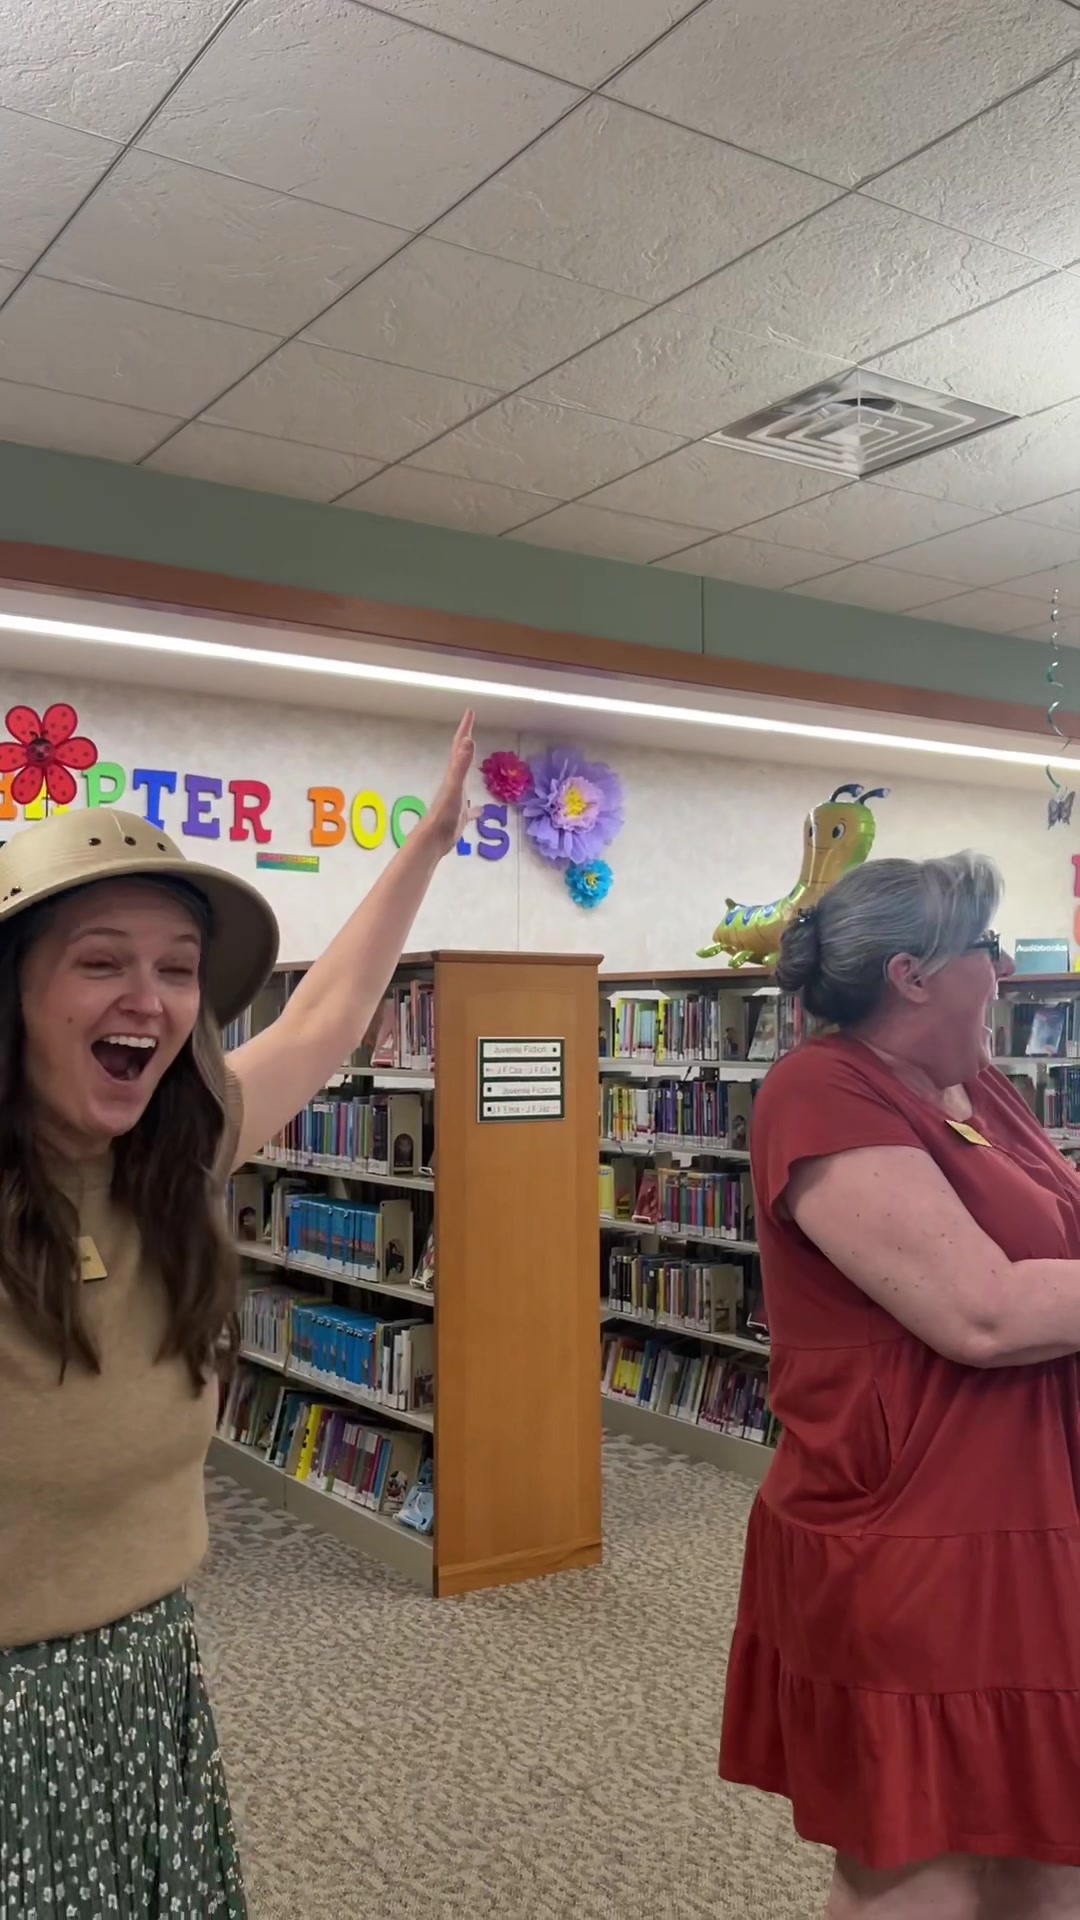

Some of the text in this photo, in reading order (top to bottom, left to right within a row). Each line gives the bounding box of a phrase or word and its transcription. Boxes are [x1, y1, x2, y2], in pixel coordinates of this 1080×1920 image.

[0, 762, 510, 861] PTER BOOS
[1016, 944, 1067, 952] Audiobooks
[523, 1045, 547, 1053] Fiction
[532, 1086, 556, 1094] Fiction
